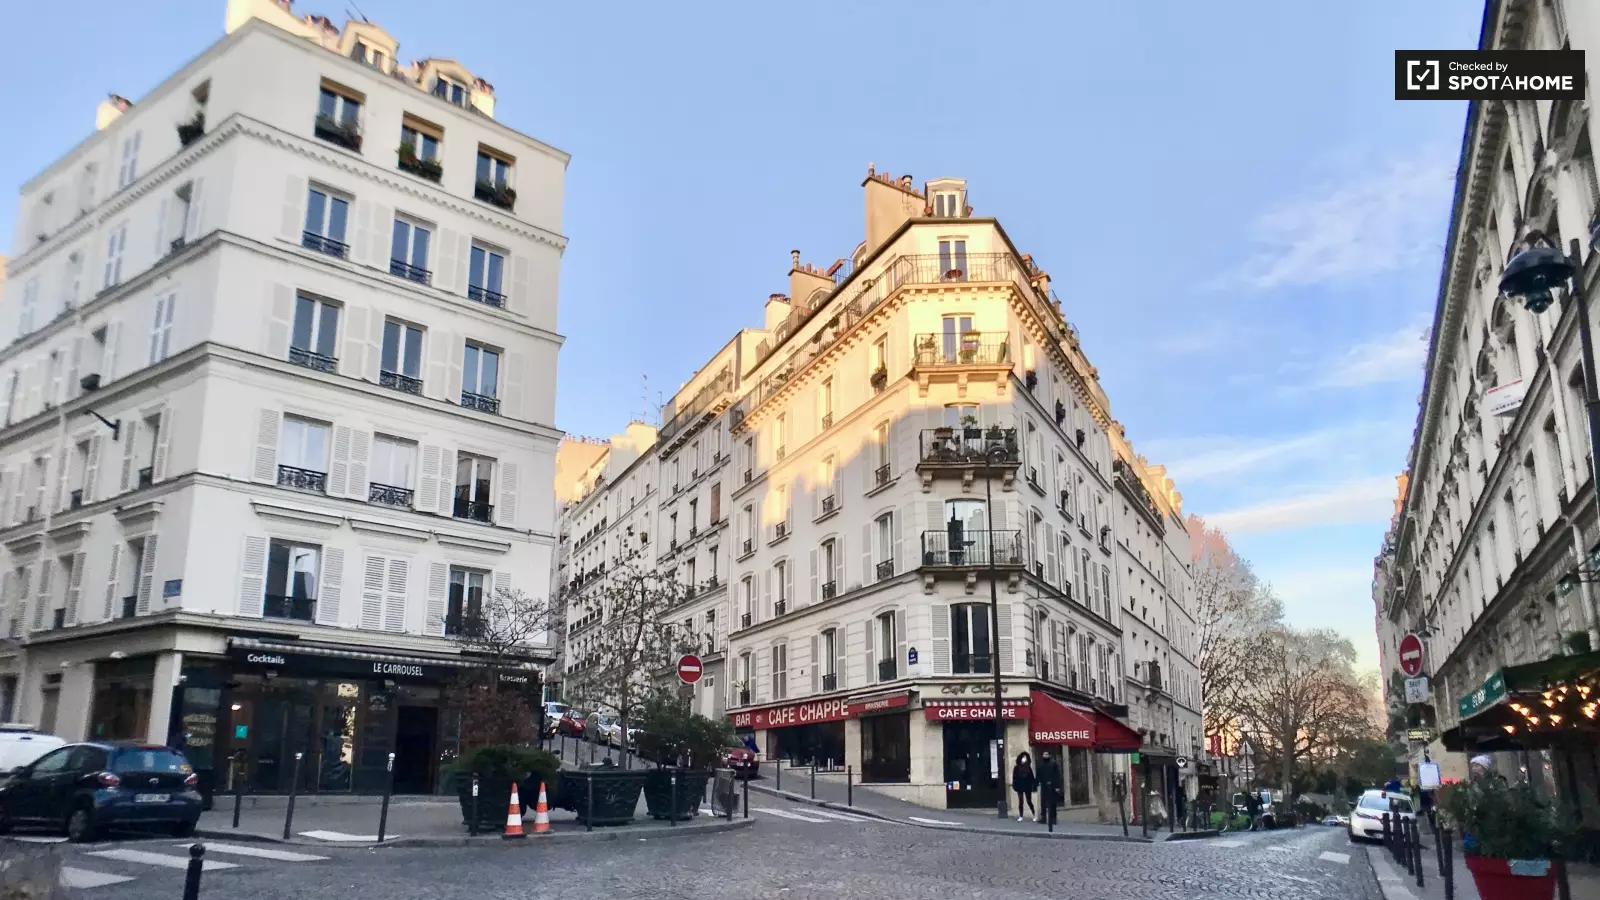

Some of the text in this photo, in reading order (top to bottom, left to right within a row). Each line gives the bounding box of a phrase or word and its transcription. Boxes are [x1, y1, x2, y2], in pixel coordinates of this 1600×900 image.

[247, 653, 285, 664] Cocktails
[373, 662, 423, 676] LE CARROUSEL
[769, 700, 849, 725] CAFE CHAPPE
[938, 708, 967, 718] CAFE
[735, 713, 751, 727] BAR
[1035, 730, 1090, 740] BRASSERIE
